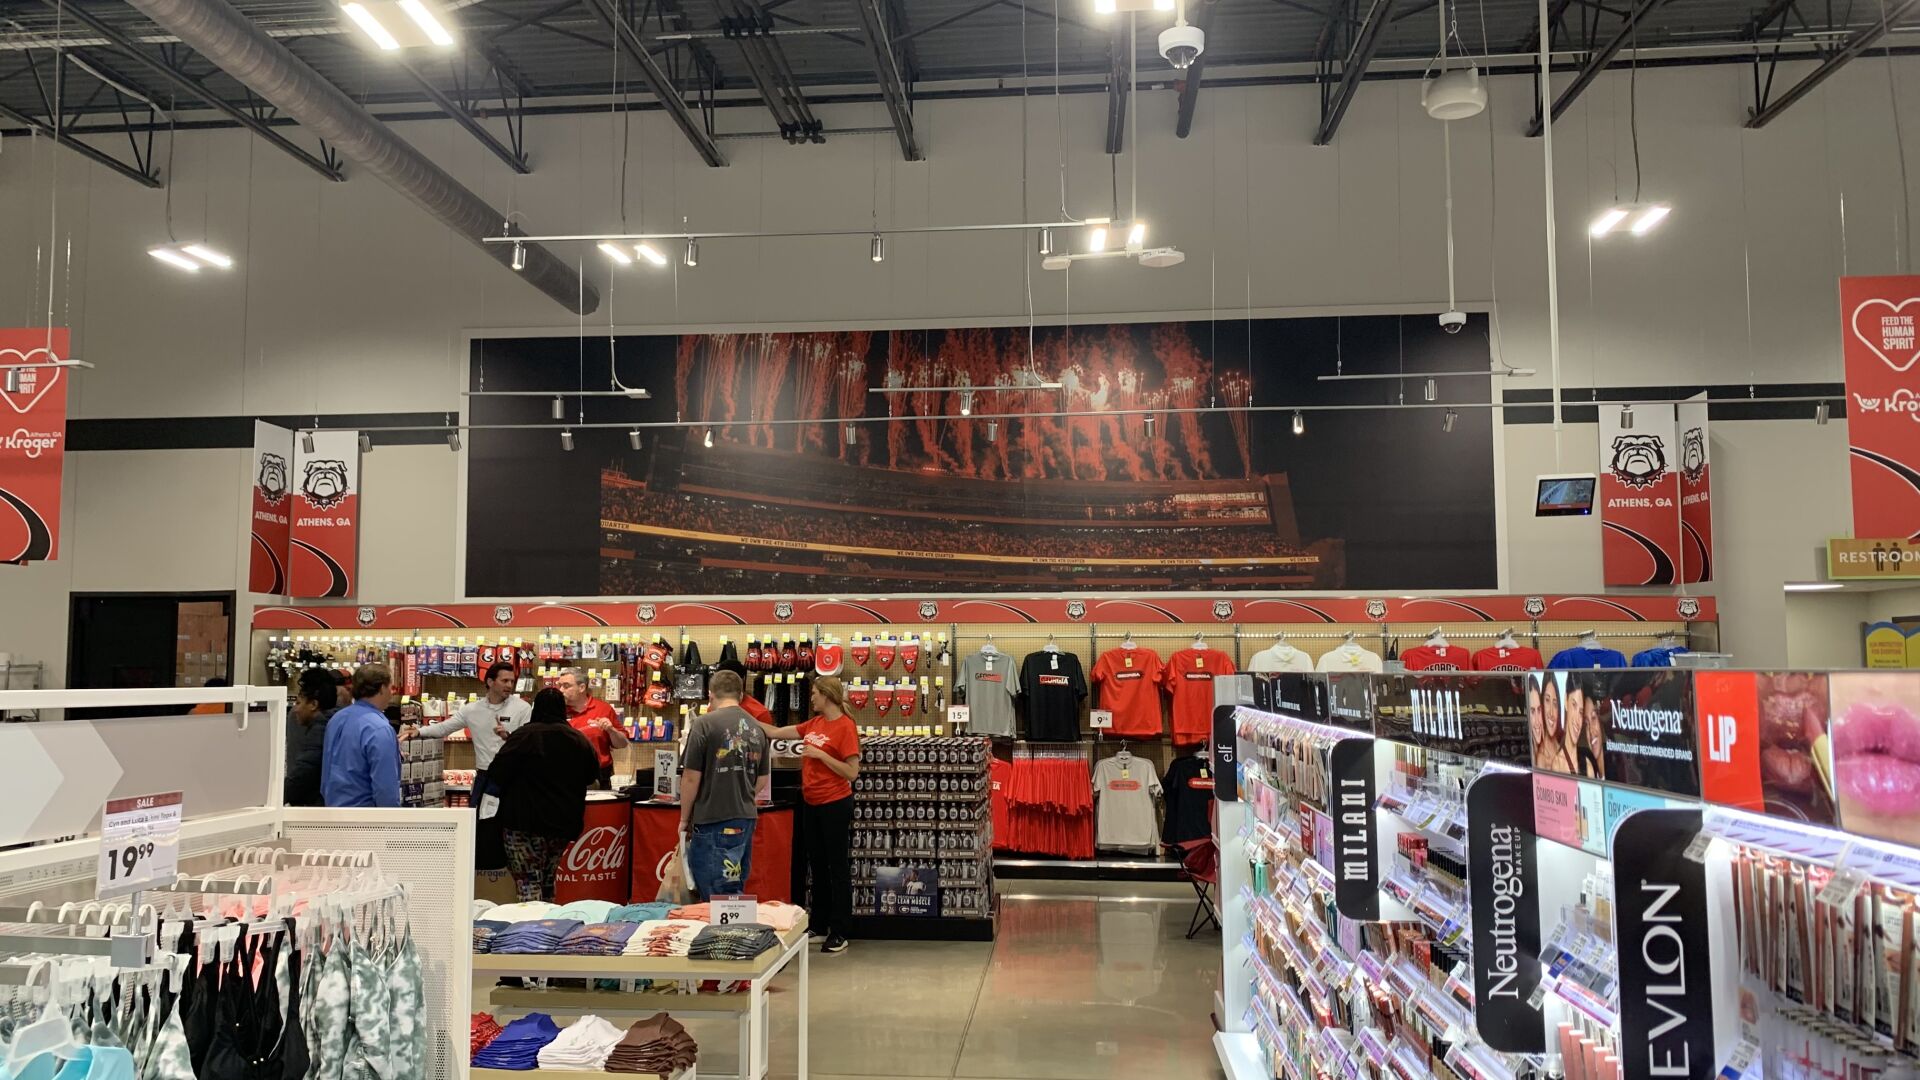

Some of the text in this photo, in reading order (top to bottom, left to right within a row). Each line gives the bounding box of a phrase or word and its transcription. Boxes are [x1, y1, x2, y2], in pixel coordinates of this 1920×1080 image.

[1881, 316, 1914, 326] FEED THE
[1881, 326, 1915, 337] HUMAN
[1883, 337, 1915, 350] SPIRIT
[1884, 389, 1920, 423] Kro
[5, 428, 57, 459] Kroger
[1608, 498, 1672, 508] ATHENS, GA
[1682, 491, 1708, 506] ATHENS, GA
[255, 510, 288, 525] ATHENS, GA
[296, 518, 351, 527] ATHENS, GA
[407, 654, 417, 687] BULLDOGS
[1410, 689, 1463, 740] MILANI
[1610, 699, 1683, 741] Neutrogena
[1707, 714, 1737, 763] LIP
[1217, 743, 1233, 763] elf
[1605, 738, 1693, 761] DERMATOLOGIST RECOMMENDED BRAND
[136, 797, 155, 808] SALE
[1535, 786, 1568, 807] COMBO SKIN
[1608, 801, 1621, 818] DRY
[109, 820, 119, 828] Cyn
[120, 818, 131, 826] and
[1340, 779, 1369, 881] MILANI
[1514, 826, 1523, 876] MAKEUP
[477, 869, 507, 883] Kroger
[582, 871, 617, 882] TASTE
[1487, 825, 1524, 1001] Neutrogena
[1641, 884, 1690, 1079] EVLON
